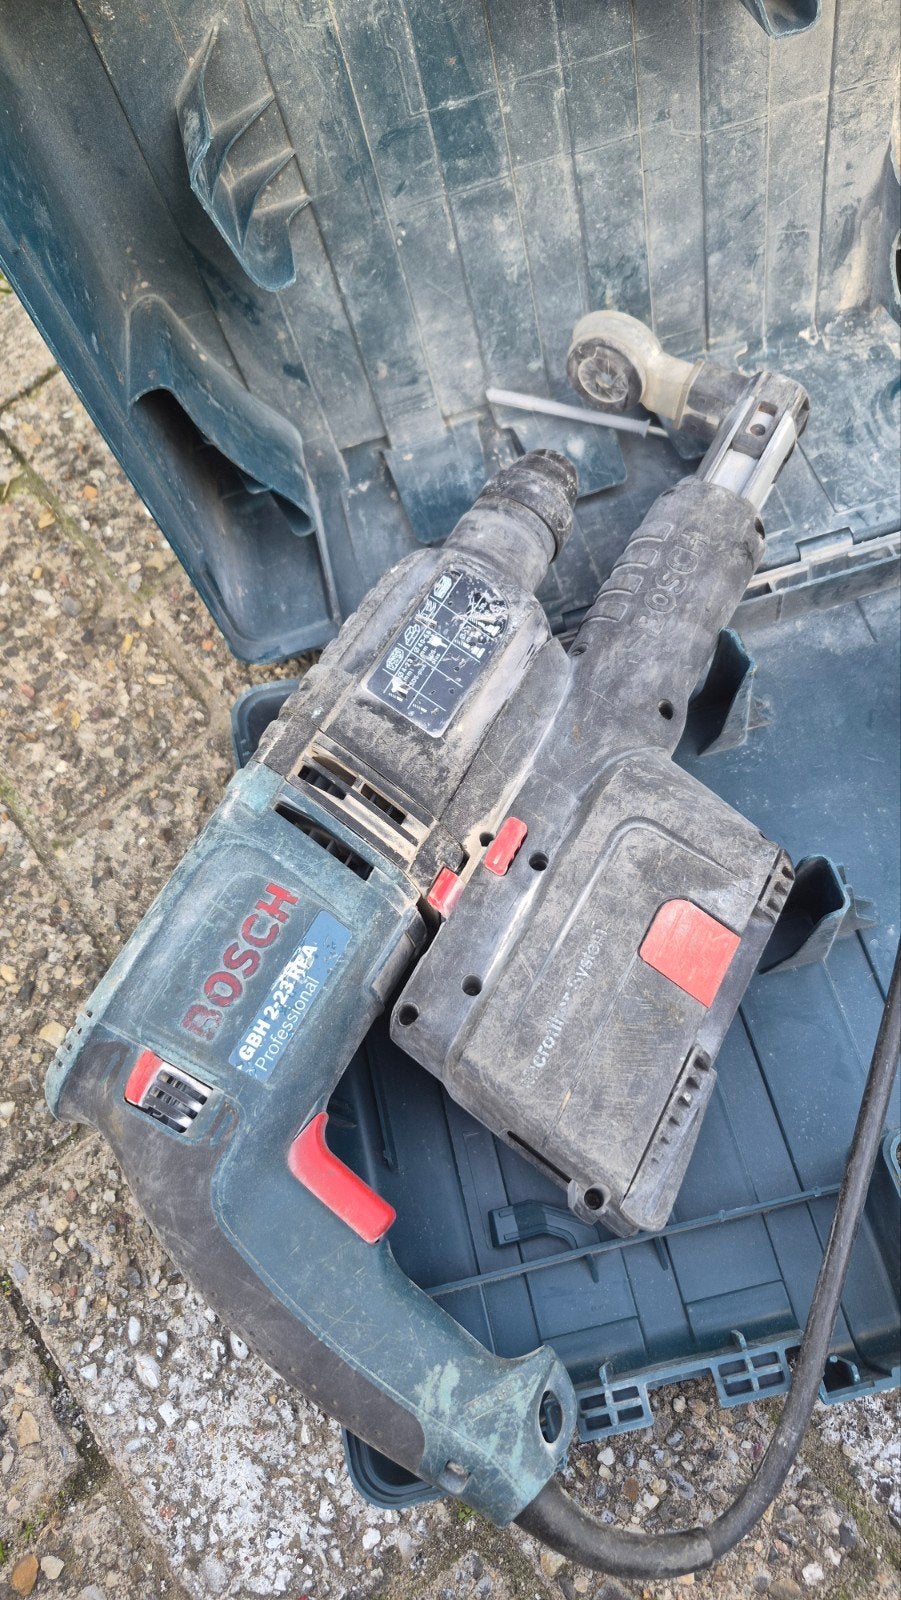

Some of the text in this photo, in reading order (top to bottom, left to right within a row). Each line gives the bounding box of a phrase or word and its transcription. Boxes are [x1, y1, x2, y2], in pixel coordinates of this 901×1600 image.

[181, 882, 299, 1041] BOSCH
[239, 1019, 271, 1061] GBH
[263, 979, 295, 1020] 2-23
[255, 977, 320, 1071] Professional
